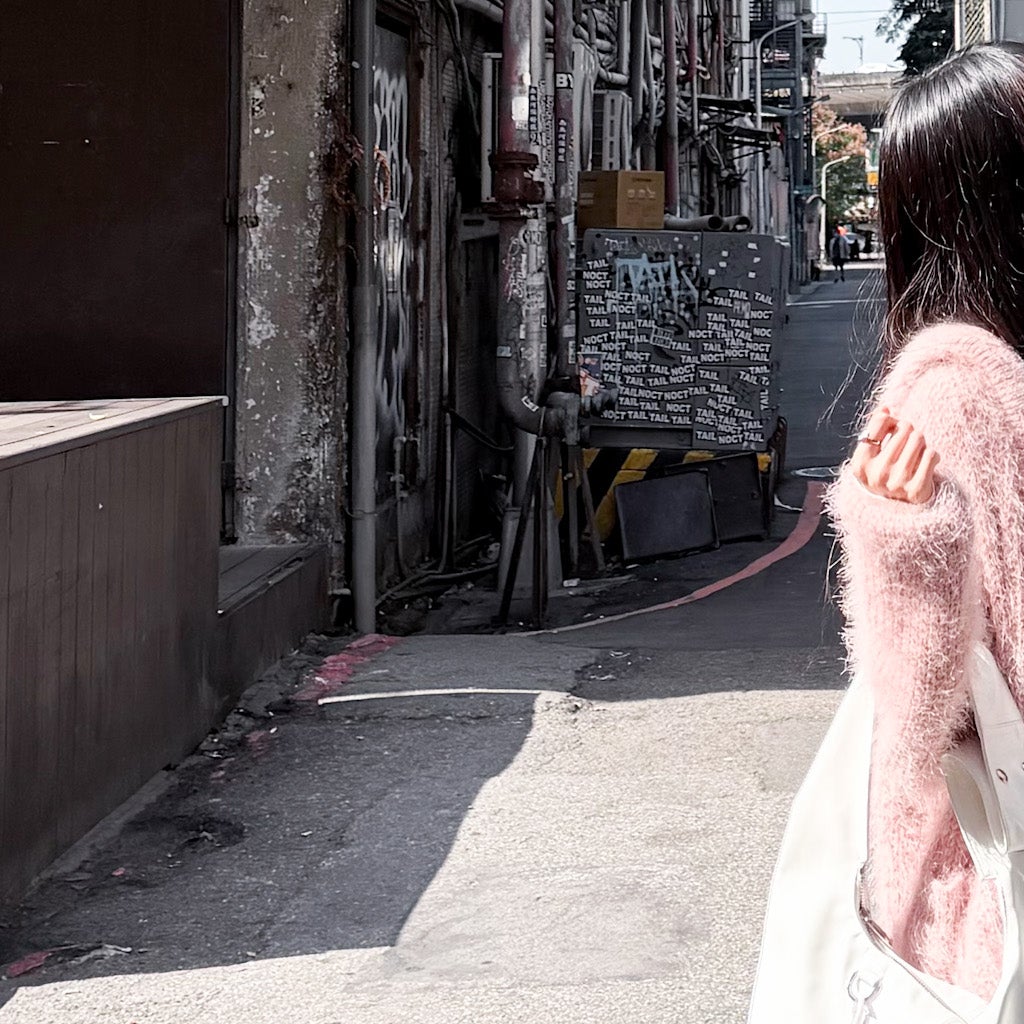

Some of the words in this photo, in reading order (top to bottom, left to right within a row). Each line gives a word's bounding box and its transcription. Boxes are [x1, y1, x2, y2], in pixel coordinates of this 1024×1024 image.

[587, 259, 609, 269] TAIL
[583, 271, 608, 280] NOCT
[586, 280, 611, 289] NOCT
[605, 290, 630, 300] NOCT
[631, 293, 651, 302] TAIL
[728, 289, 748, 300] TAIL
[755, 292, 773, 305] TAIL
[584, 295, 605, 304] TAIL
[713, 296, 733, 307] TAIL
[586, 307, 607, 315] TAIL
[612, 305, 636, 314] NOCT
[707, 313, 727, 321] TAIL
[590, 319, 610, 327] TAIL
[616, 321, 635, 330] TAIL
[637, 319, 656, 328] TAIL
[707, 322, 726, 332] TAIL
[730, 319, 750, 328] TAIL
[583, 333, 609, 344] NOCT
[609, 331, 629, 339] TAIL
[688, 330, 713, 338] NOCT
[734, 328, 752, 341] TAIL
[629, 335, 649, 343] TAIL
[725, 338, 745, 346] TAIL
[601, 342, 627, 350] NOCT
[671, 341, 692, 351] TAIL
[703, 343, 723, 352] TAIL
[746, 342, 771, 352] NOCT
[625, 351, 651, 361] NOCT
[700, 353, 725, 362] NOCT
[725, 349, 750, 357] NOCT
[749, 352, 769, 361] TAIL
[680, 355, 701, 364] TAIL
[601, 362, 622, 371] OCT
[622, 364, 647, 373] NOCT
[649, 364, 670, 375] TAIL
[671, 364, 696, 376] NOCT
[749, 365, 770, 374] TAIL
[669, 374, 695, 383] NOCT
[699, 370, 719, 380] TAIL
[739, 371, 758, 385] TAIL
[624, 375, 645, 386] TAIL
[647, 376, 669, 386] TAIL
[619, 386, 640, 397] TAIL
[688, 387, 709, 395] TAIL
[709, 384, 730, 393] TAIL
[639, 389, 664, 400] NOCT
[663, 390, 689, 400] NOCT
[619, 397, 639, 406] TAIL
[717, 395, 737, 405] TAIL
[760, 389, 769, 410] TAIL
[640, 402, 660, 410] TAIL
[666, 403, 691, 413] NOCT
[627, 411, 649, 419] TAIL
[650, 413, 670, 422] TAIL
[696, 408, 717, 418] TAIL
[733, 408, 754, 419] TAIL
[671, 416, 692, 424] TAIL
[718, 415, 738, 426] TAIL
[718, 424, 742, 434] NOCT
[742, 420, 763, 430] TAIL
[696, 431, 717, 440] TAIL
[718, 434, 743, 444] NOCT
[743, 432, 764, 441] TAIL
